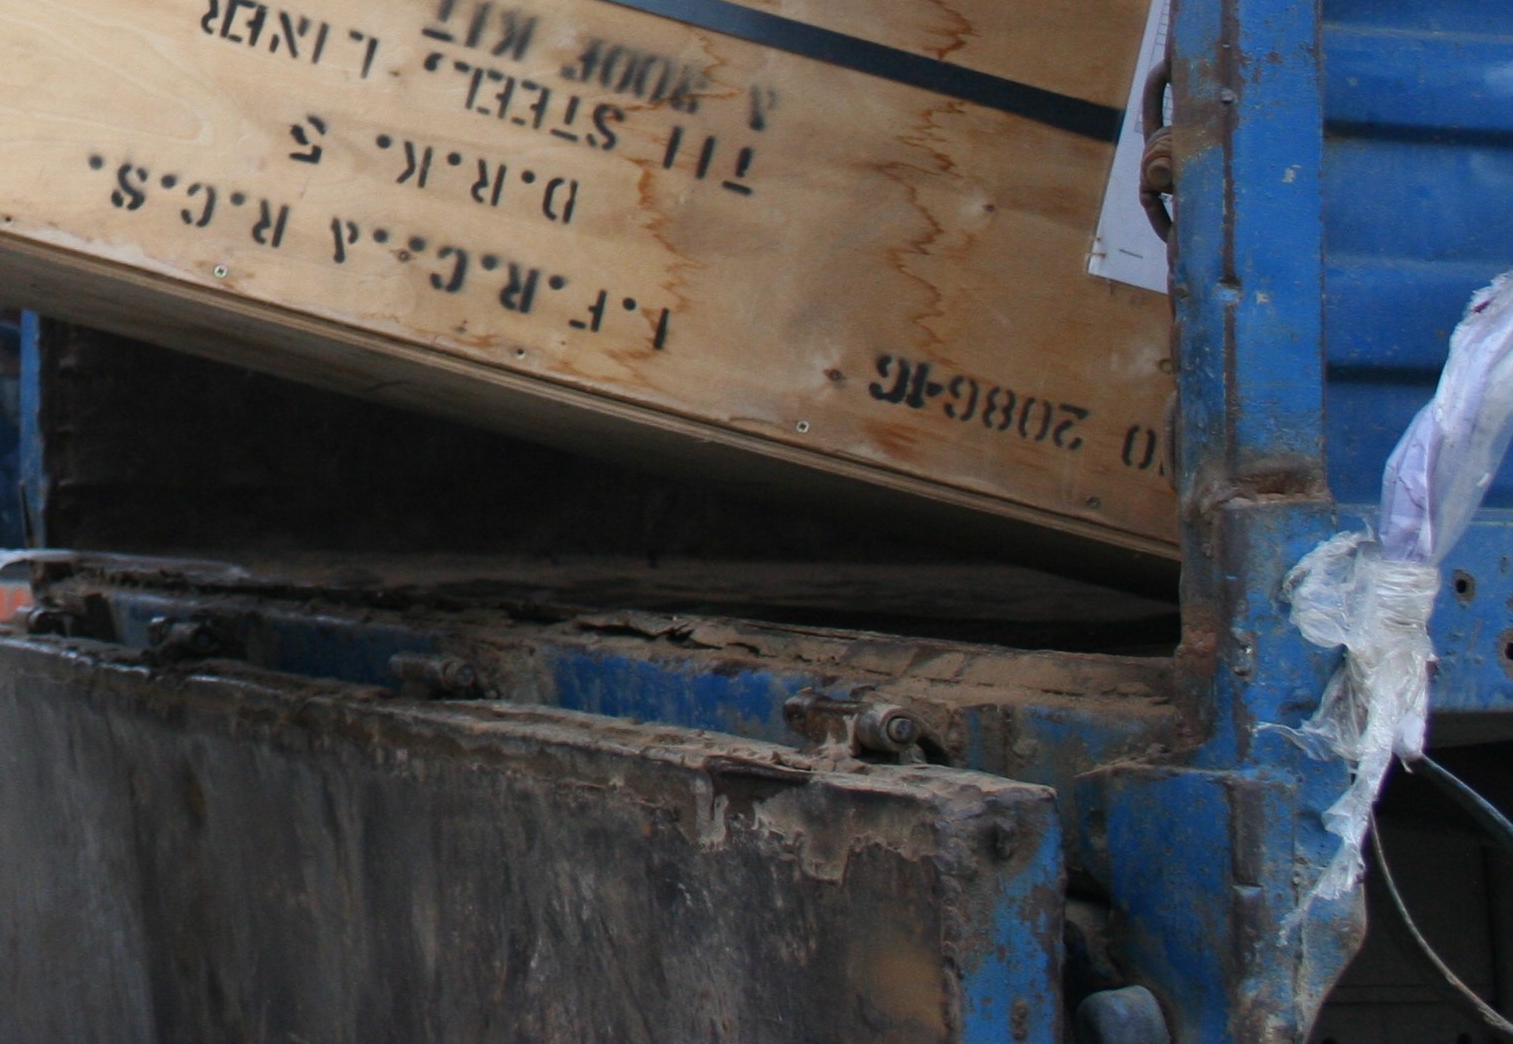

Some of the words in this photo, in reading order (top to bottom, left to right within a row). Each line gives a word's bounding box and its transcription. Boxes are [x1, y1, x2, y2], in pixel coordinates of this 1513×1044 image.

[422, 51, 626, 150] STEEL,
[560, 36, 710, 114] ROOF
[288, 113, 329, 165] 5
[376, 133, 579, 224] D.R.K.
[88, 154, 290, 249] R.C.S.
[1120, 424, 1170, 478] O
